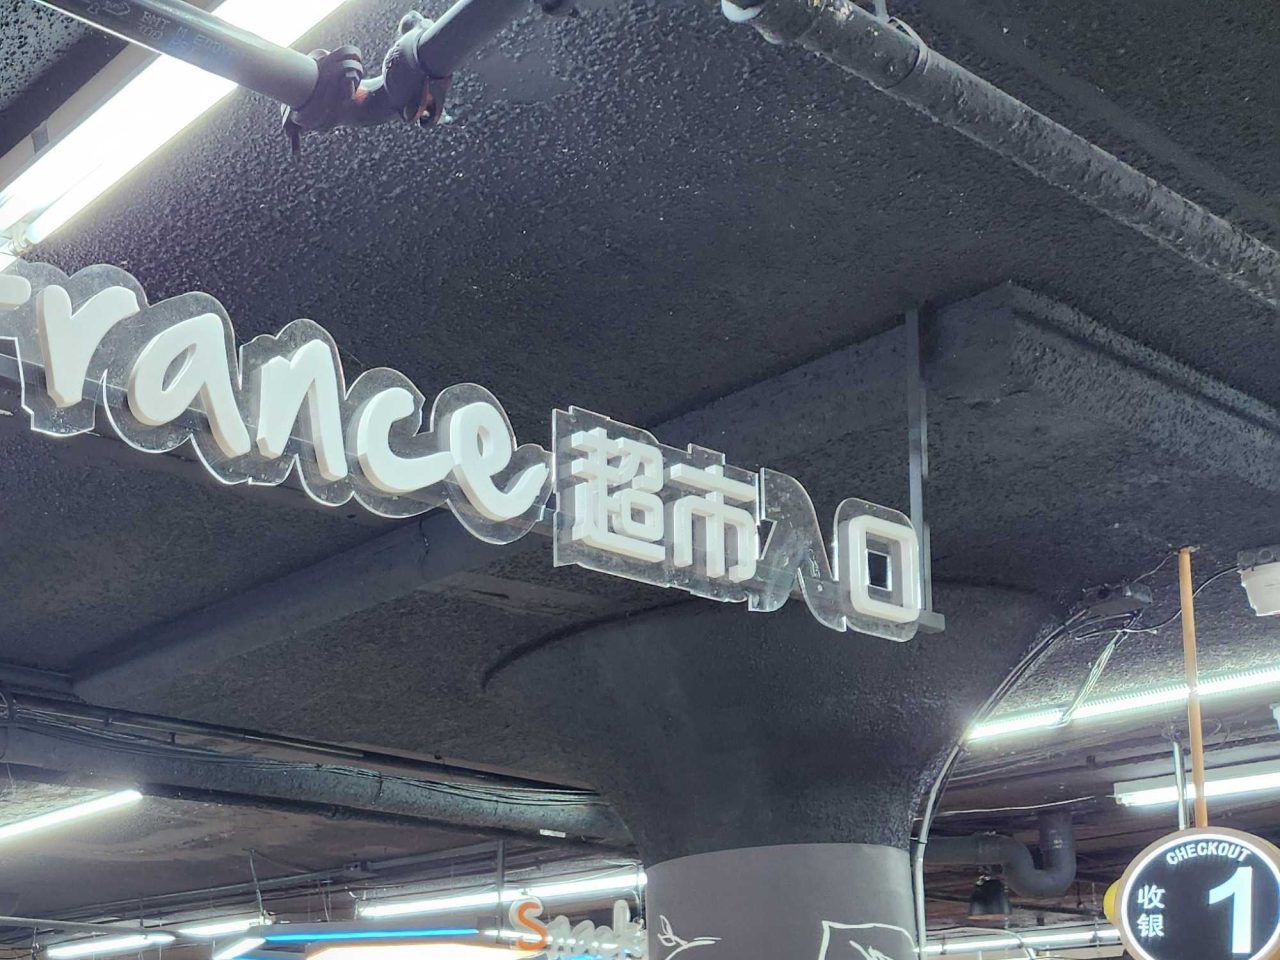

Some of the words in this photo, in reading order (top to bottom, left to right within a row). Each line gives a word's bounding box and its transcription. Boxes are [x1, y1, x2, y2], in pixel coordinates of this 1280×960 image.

[1165, 841, 1253, 865] CHECKOUT
[1136, 884, 1166, 938] 收银
[1208, 865, 1253, 954] 1
